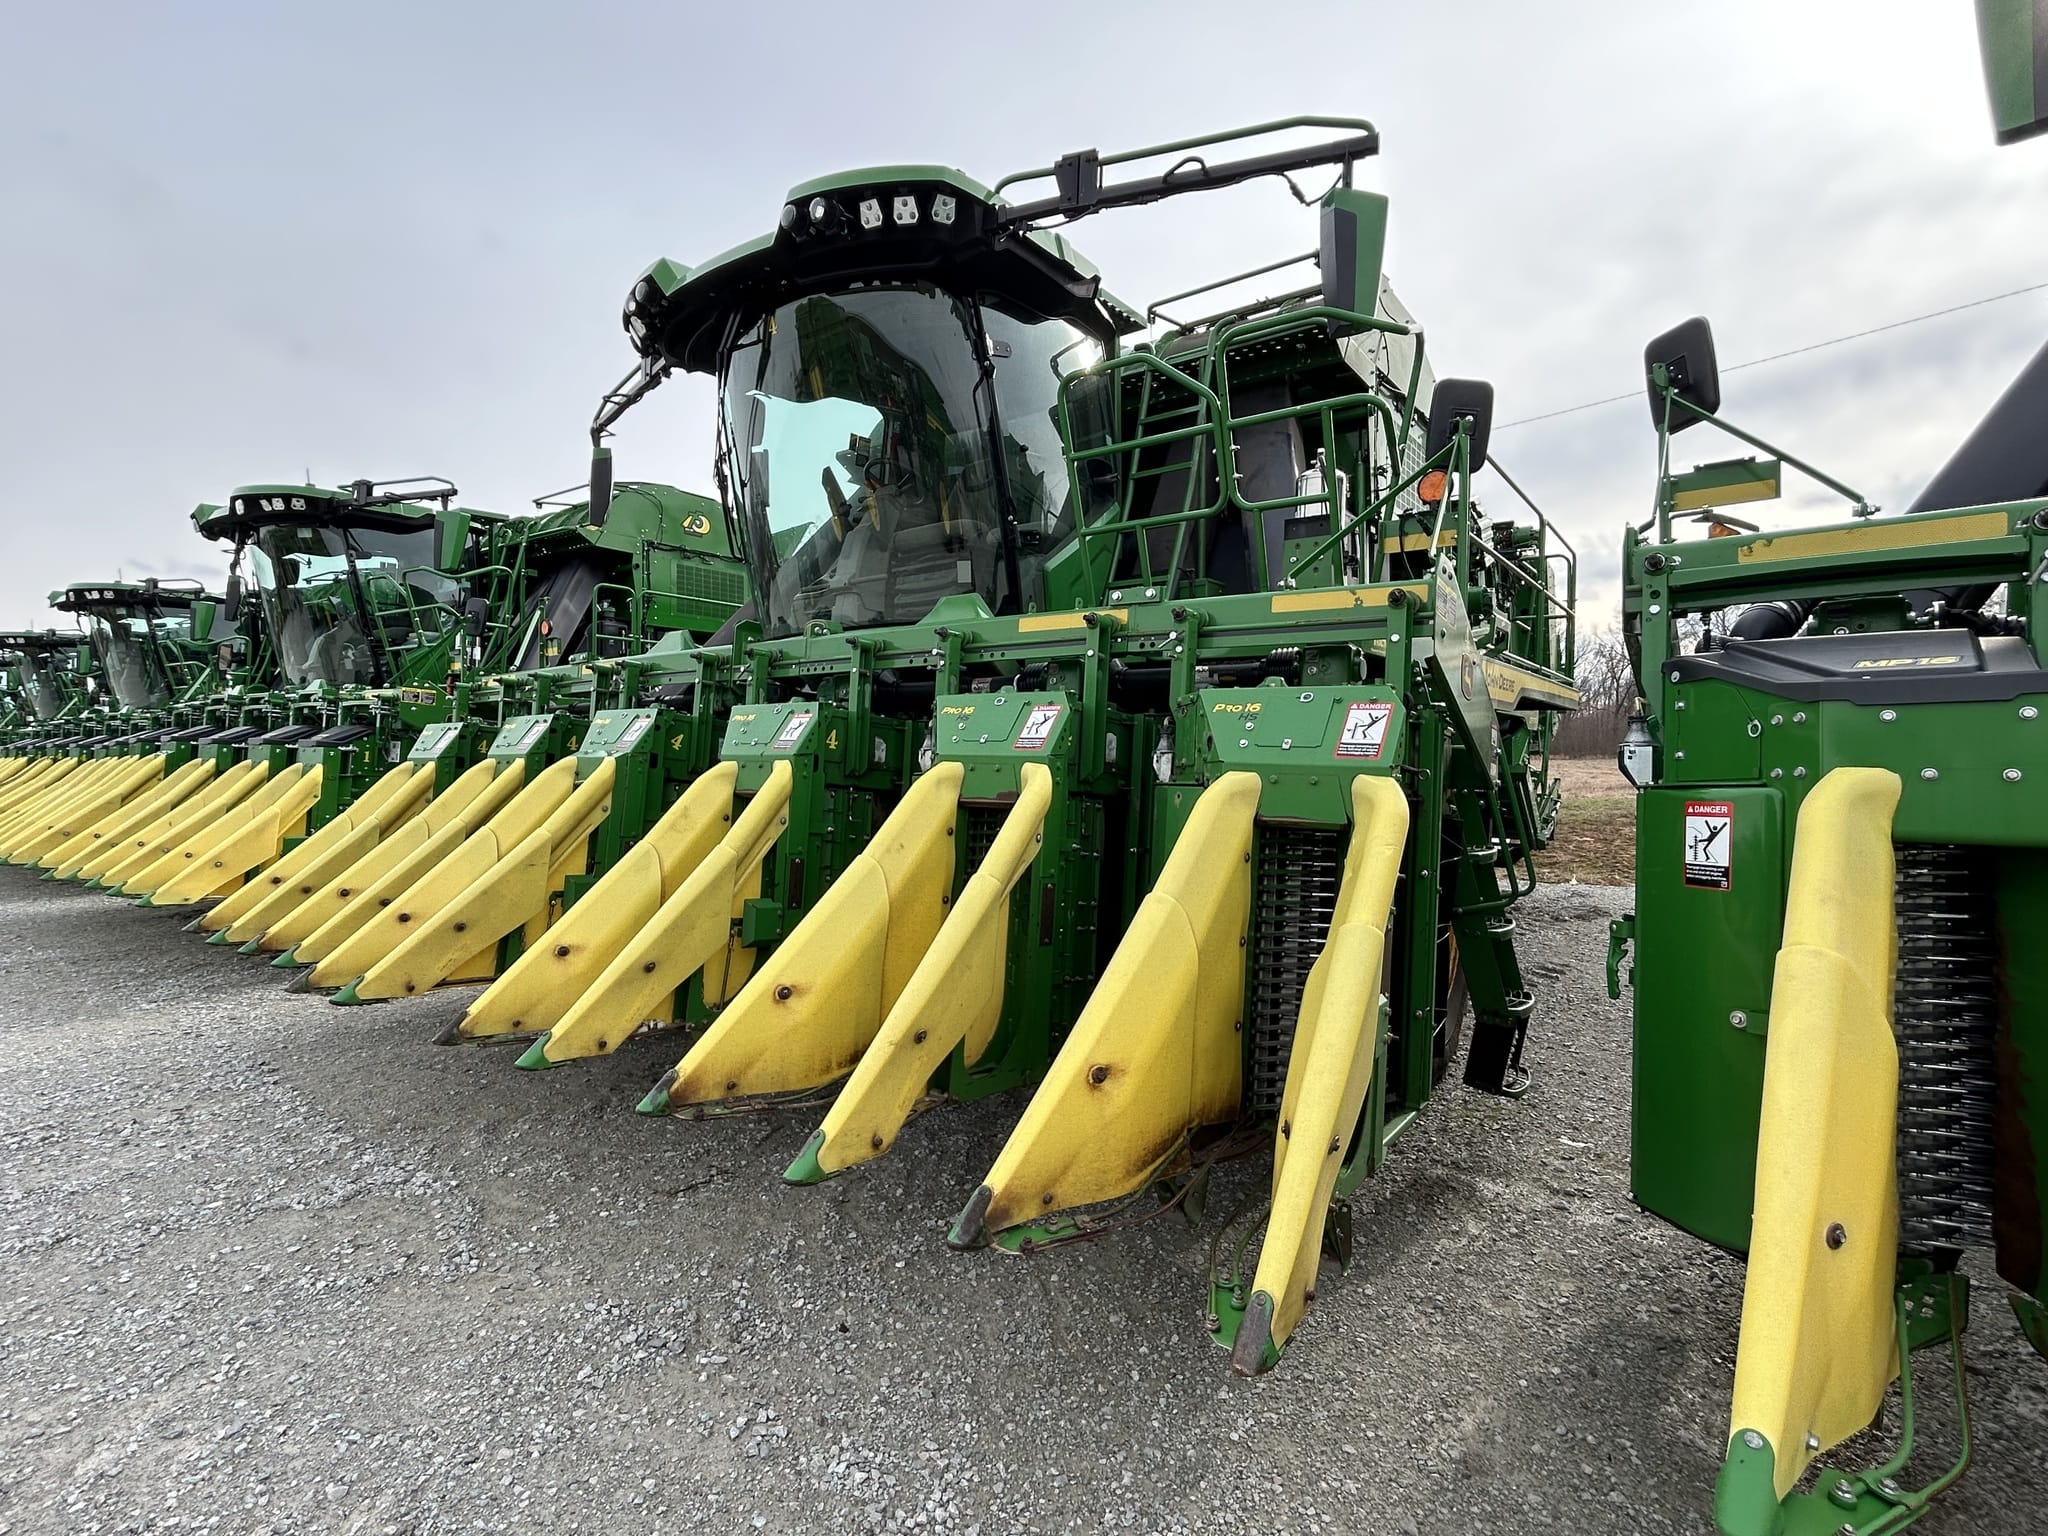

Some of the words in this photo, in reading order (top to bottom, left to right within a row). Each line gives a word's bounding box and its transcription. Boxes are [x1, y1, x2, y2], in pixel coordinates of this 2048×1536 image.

[1238, 712, 1259, 721] HS
[477, 739, 488, 753] 4
[566, 735, 579, 751] 4
[671, 734, 684, 751] 4
[826, 729, 838, 750] 4
[1694, 805, 1728, 814] DANGER
